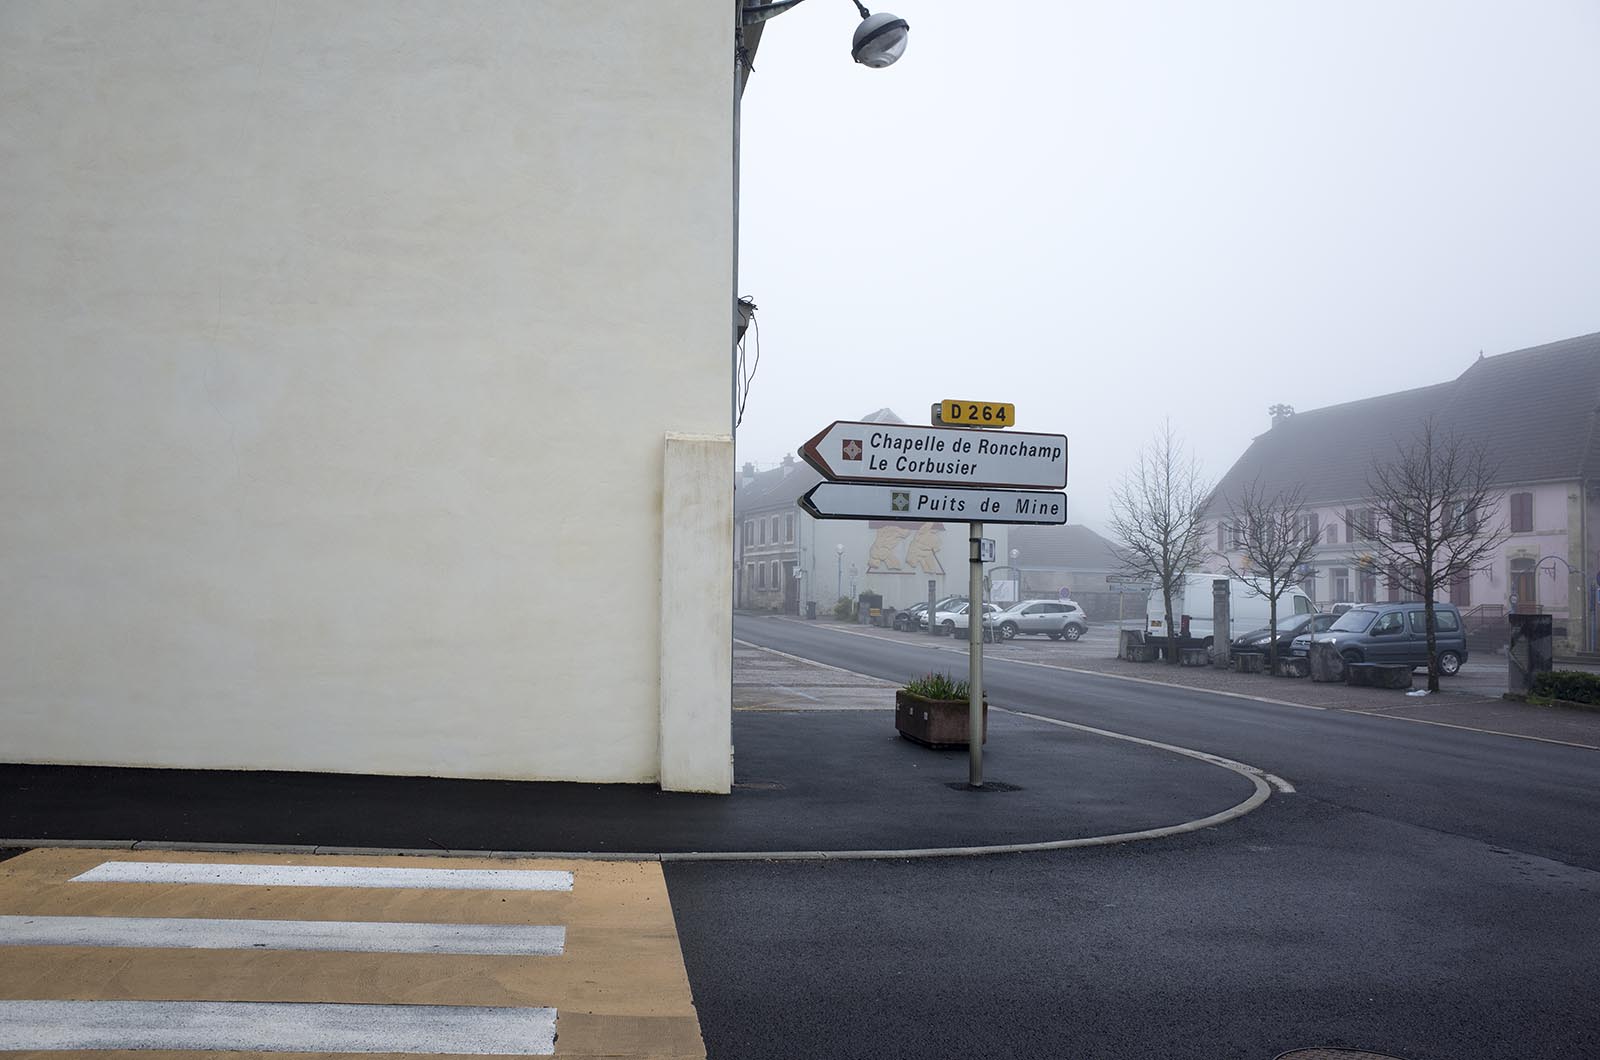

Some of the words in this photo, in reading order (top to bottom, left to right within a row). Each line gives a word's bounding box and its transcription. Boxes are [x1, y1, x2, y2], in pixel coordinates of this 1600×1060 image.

[952, 404, 961, 419] D
[968, 405, 1007, 422] 264
[870, 432, 946, 454] Chapelle
[952, 437, 971, 453] de
[978, 439, 1062, 462] Ronchamp
[869, 454, 888, 471] Le
[896, 456, 977, 475] Corbusier
[917, 495, 966, 512] Puits
[980, 497, 1001, 513] de
[1016, 498, 1059, 515] Mine
